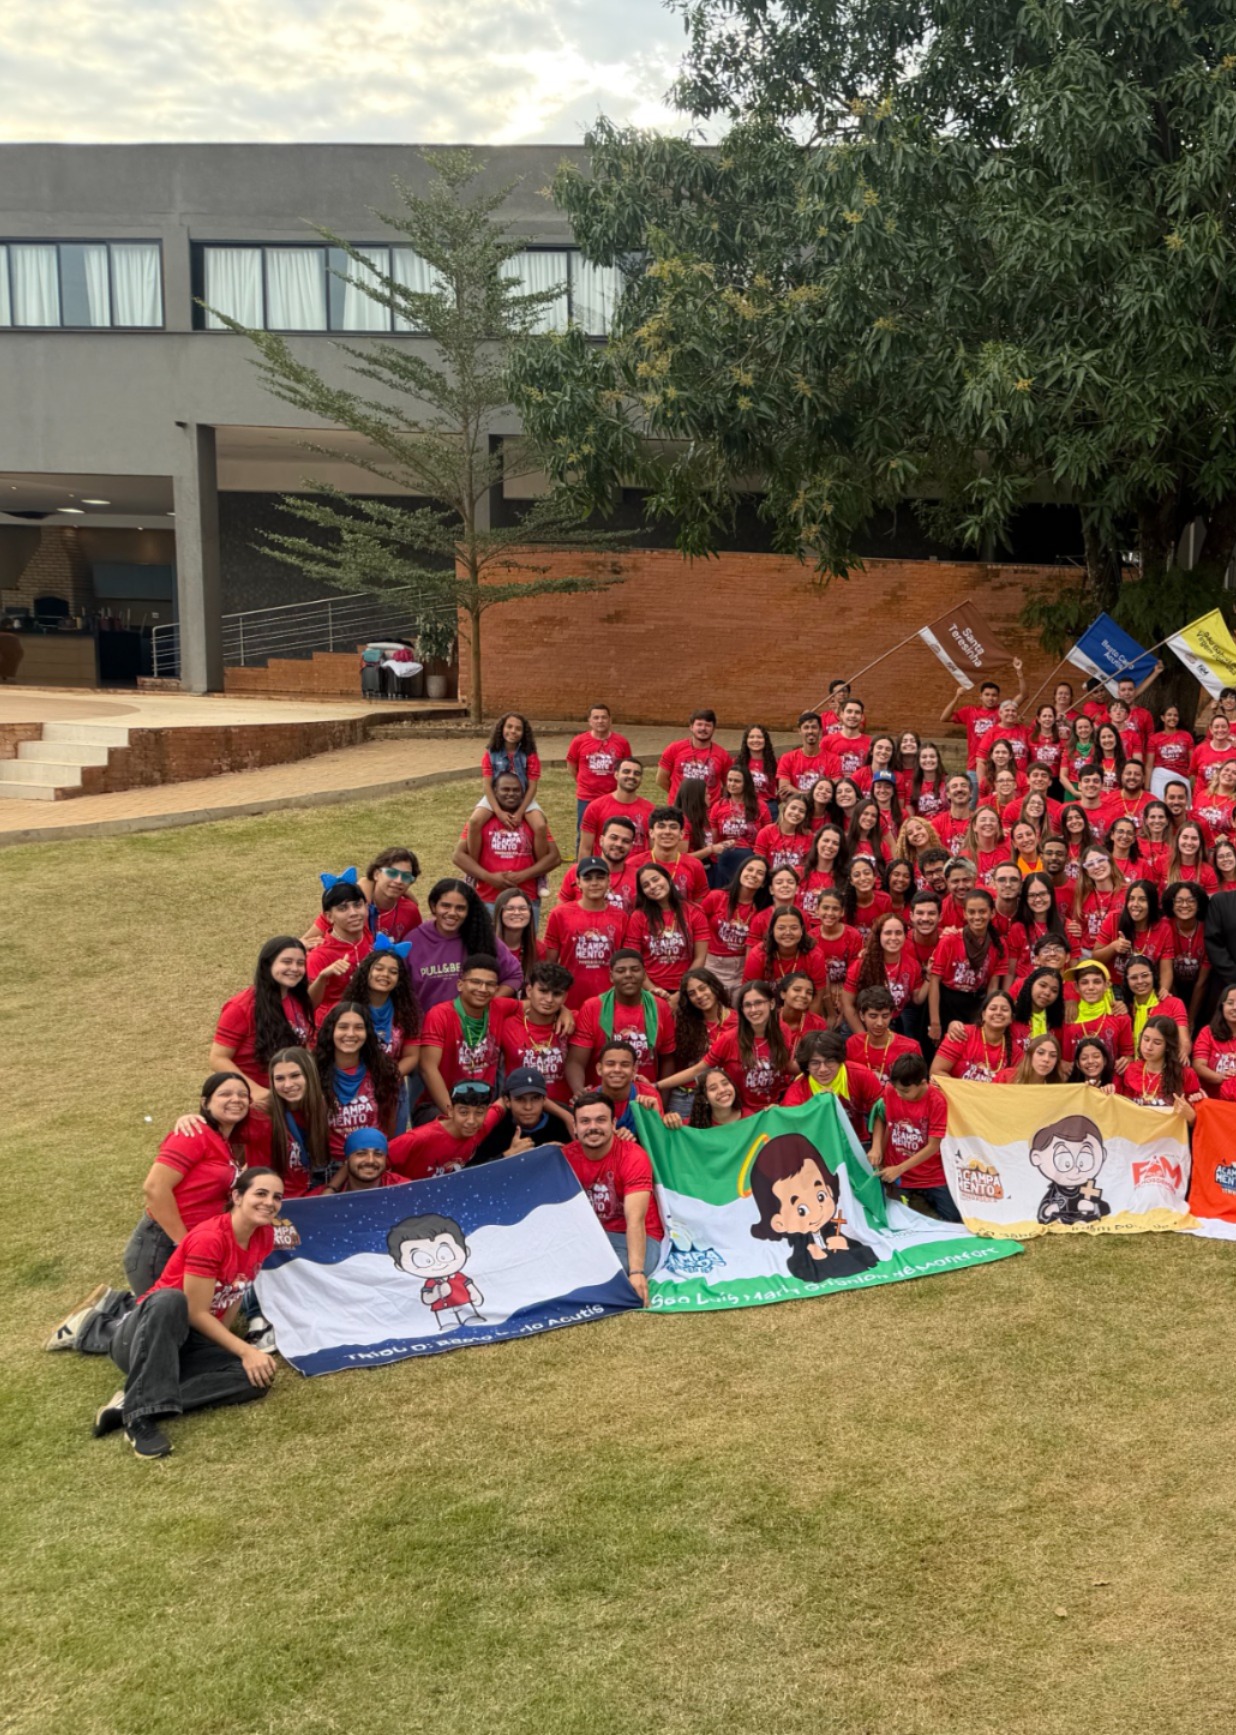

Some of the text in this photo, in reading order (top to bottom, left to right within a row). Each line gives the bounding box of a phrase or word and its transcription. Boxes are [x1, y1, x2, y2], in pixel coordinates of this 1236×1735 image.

[948, 623, 983, 668] Teresinha
[963, 627, 984, 654] Santa
[575, 942, 609, 951] ACAMPA
[575, 950, 604, 959] MENTO
[338, 1103, 373, 1118] CAMPA
[328, 1113, 367, 1128] MENTO
[274, 1226, 297, 1236] MPA
[915, 1247, 1000, 1273] Montfort
[547, 1303, 605, 1326] Acutis
